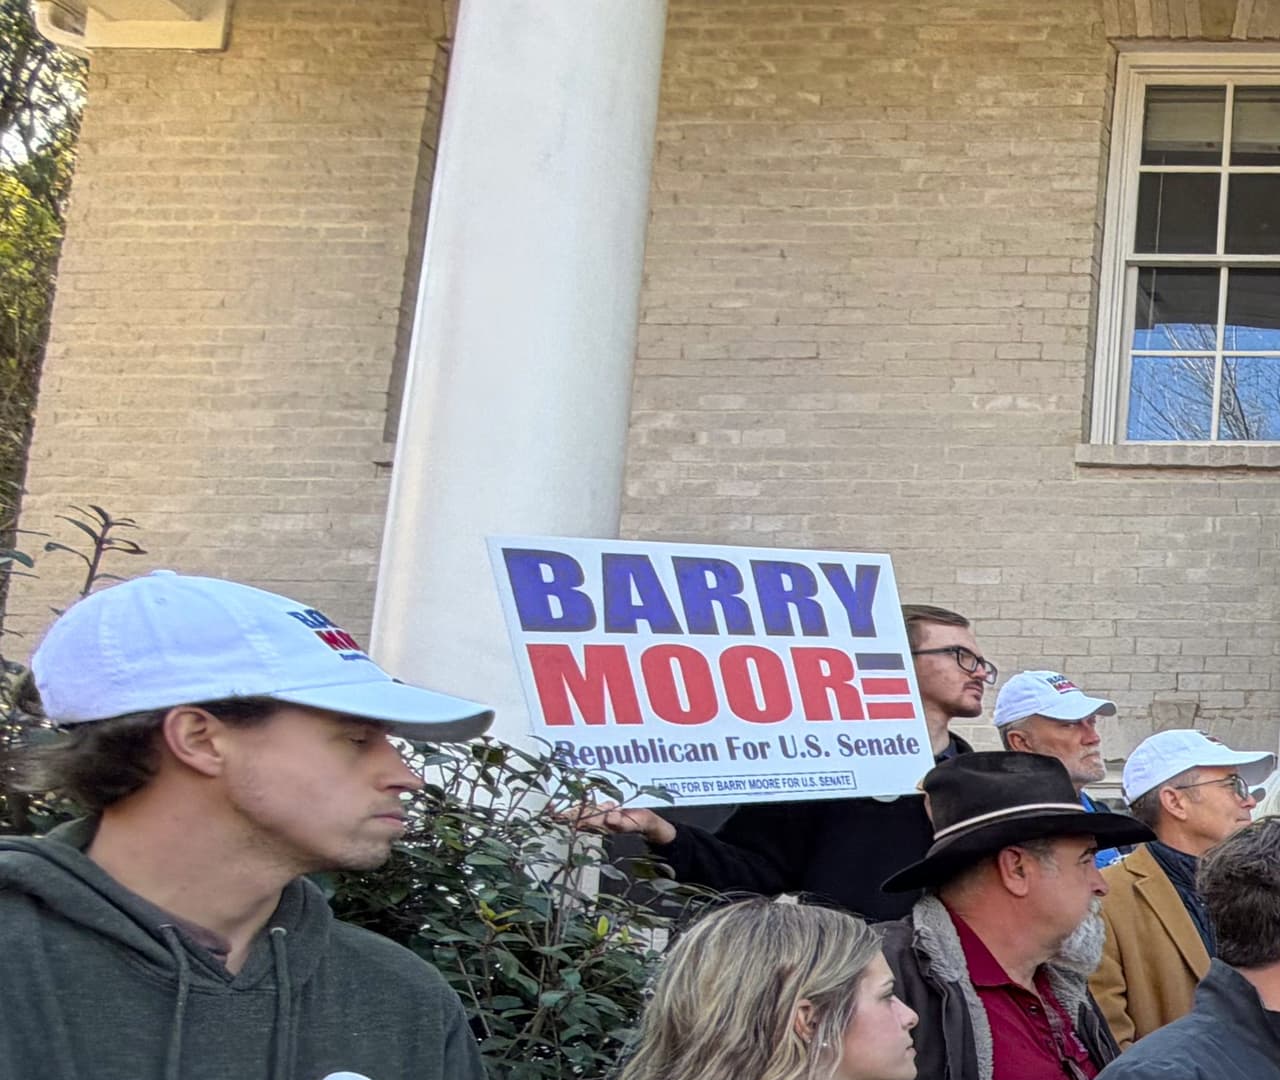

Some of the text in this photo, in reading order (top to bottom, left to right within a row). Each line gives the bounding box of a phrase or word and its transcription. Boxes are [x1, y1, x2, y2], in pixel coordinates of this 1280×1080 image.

[500, 547, 881, 638] BARRY
[526, 643, 916, 726] MOORE
[725, 736, 771, 760] For
[780, 734, 831, 759] U.S.
[837, 733, 921, 757] Senate
[681, 774, 851, 792] FOR BY BARRY MOORE FOR U.S. SENATE
